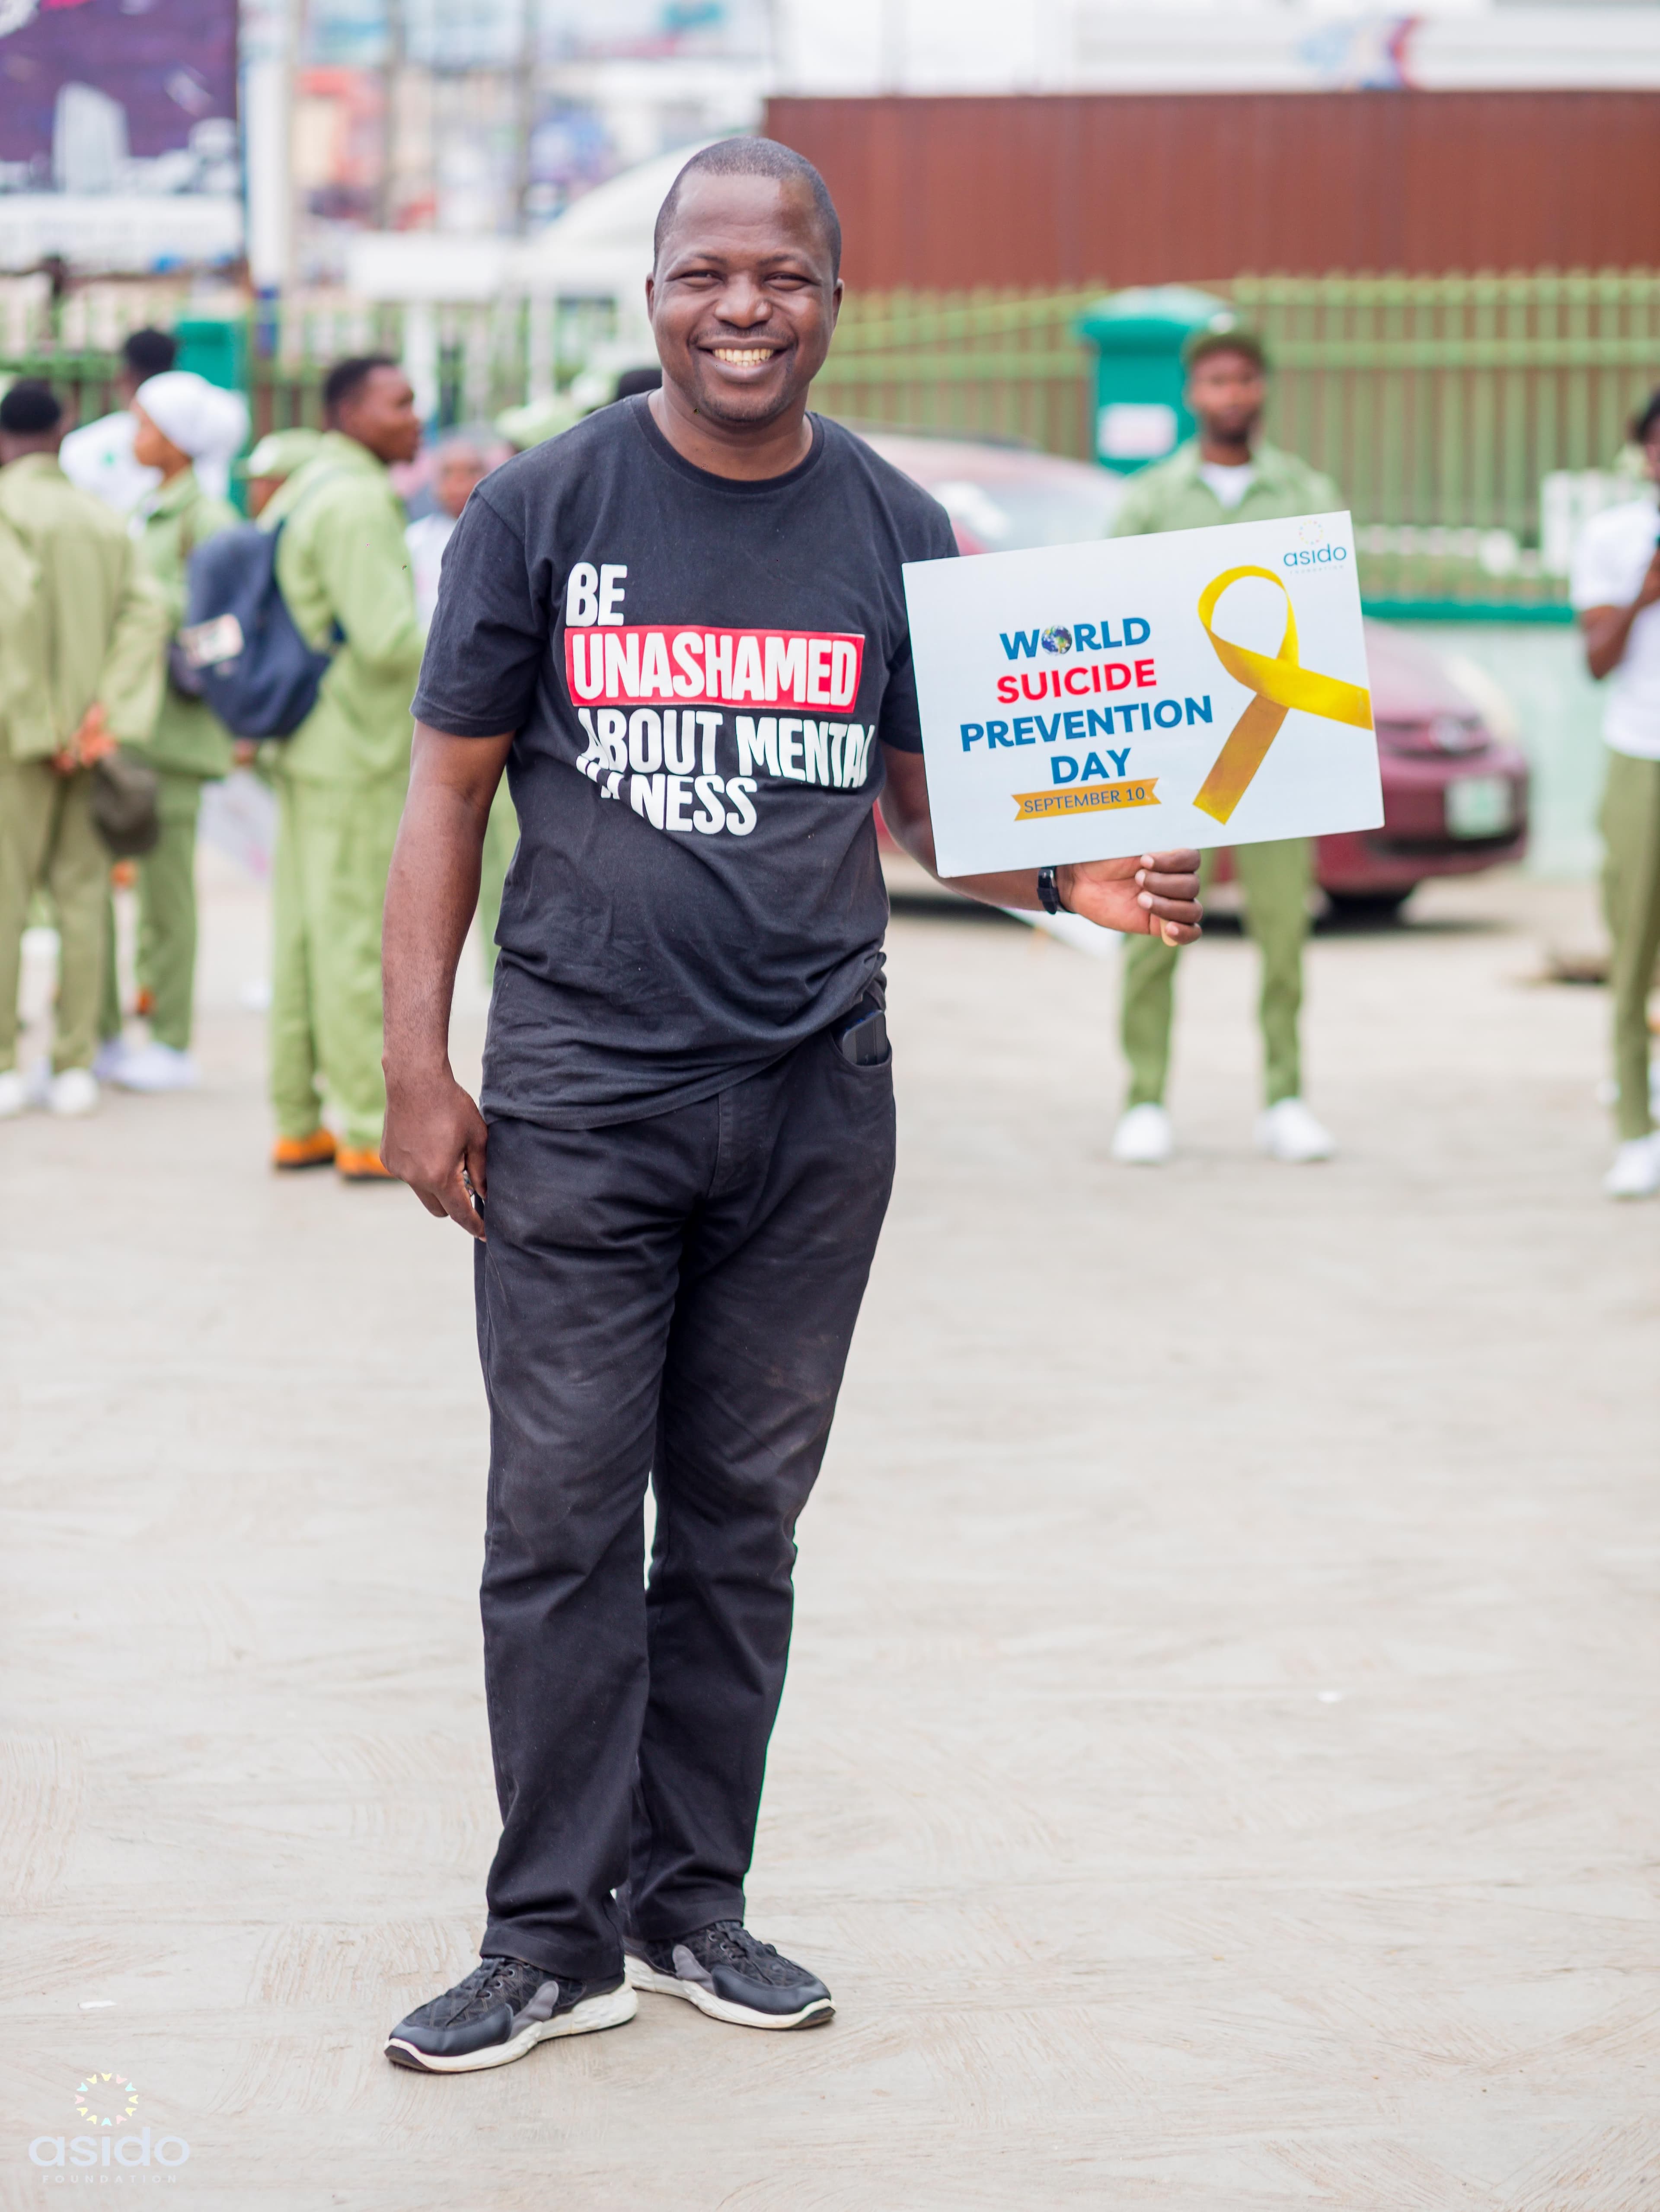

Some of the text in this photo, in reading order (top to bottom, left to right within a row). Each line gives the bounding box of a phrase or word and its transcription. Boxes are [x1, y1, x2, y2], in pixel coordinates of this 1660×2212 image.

[1283, 543, 1347, 567] asido
[565, 562, 628, 627] BE
[572, 632, 857, 706] UNASHAMED
[997, 659, 1157, 704] SUICIDE
[578, 708, 723, 775] ABOUT
[960, 695, 1213, 752] PREVENTION
[1050, 747, 1131, 784] DAY
[1024, 787, 1145, 813] SEPTEMBER 10
